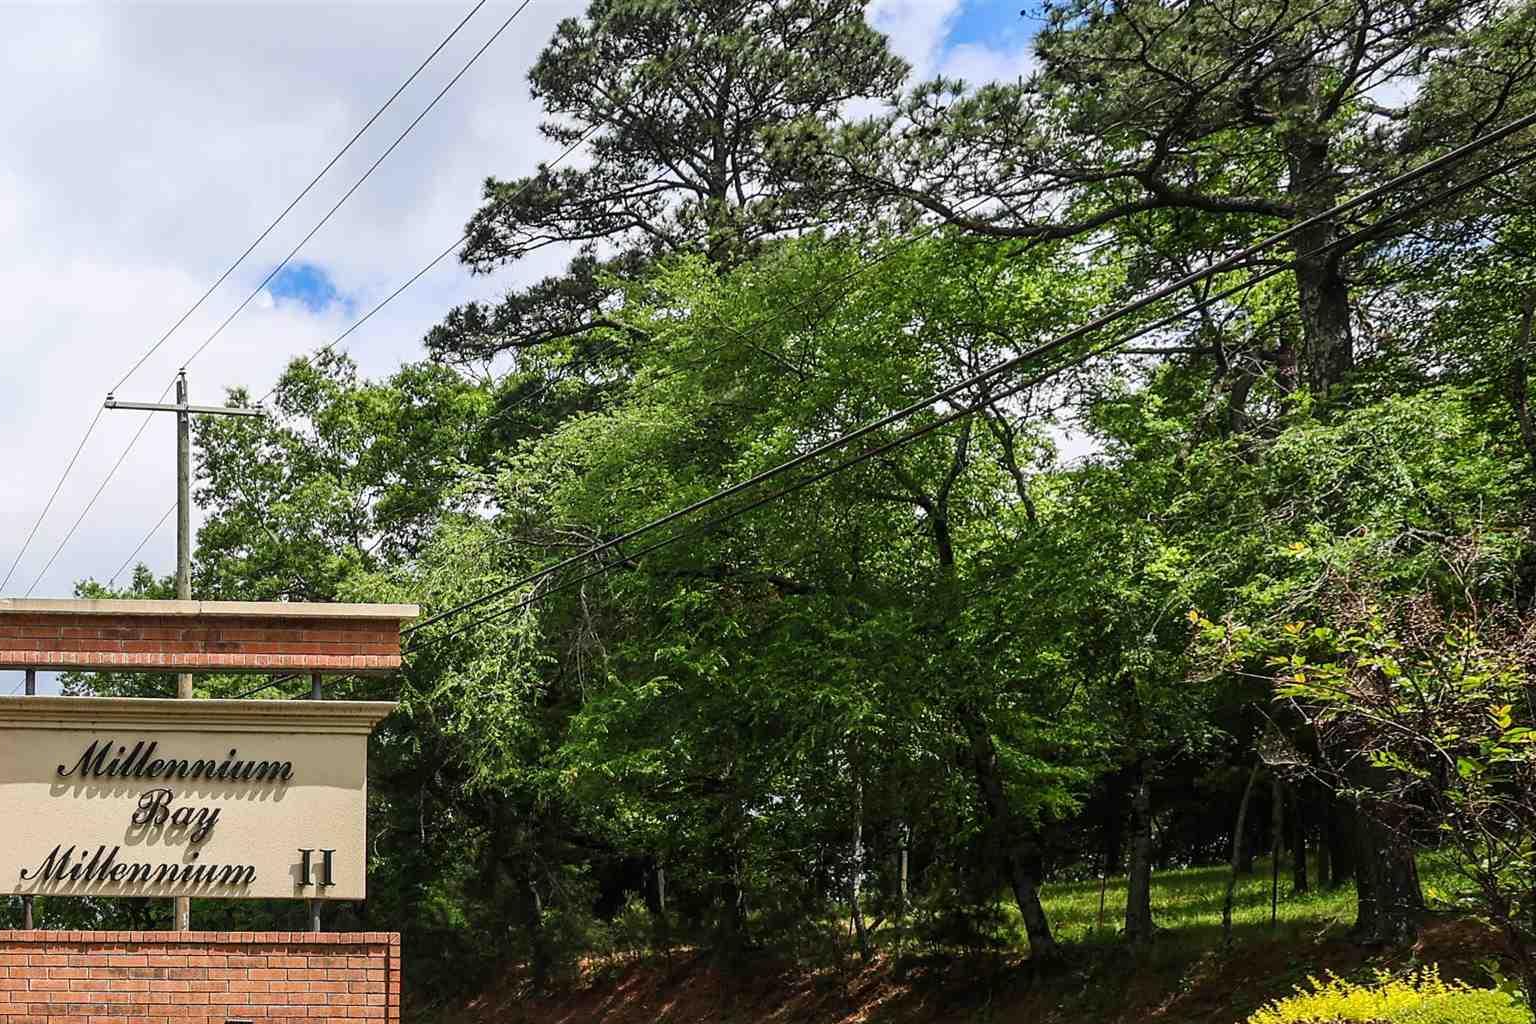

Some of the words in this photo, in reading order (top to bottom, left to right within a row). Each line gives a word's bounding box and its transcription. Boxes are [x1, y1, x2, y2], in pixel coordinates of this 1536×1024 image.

[57, 740, 294, 782] Millennium
[131, 789, 222, 842] Bay
[20, 844, 256, 885] Millennium
[298, 848, 337, 887] II
